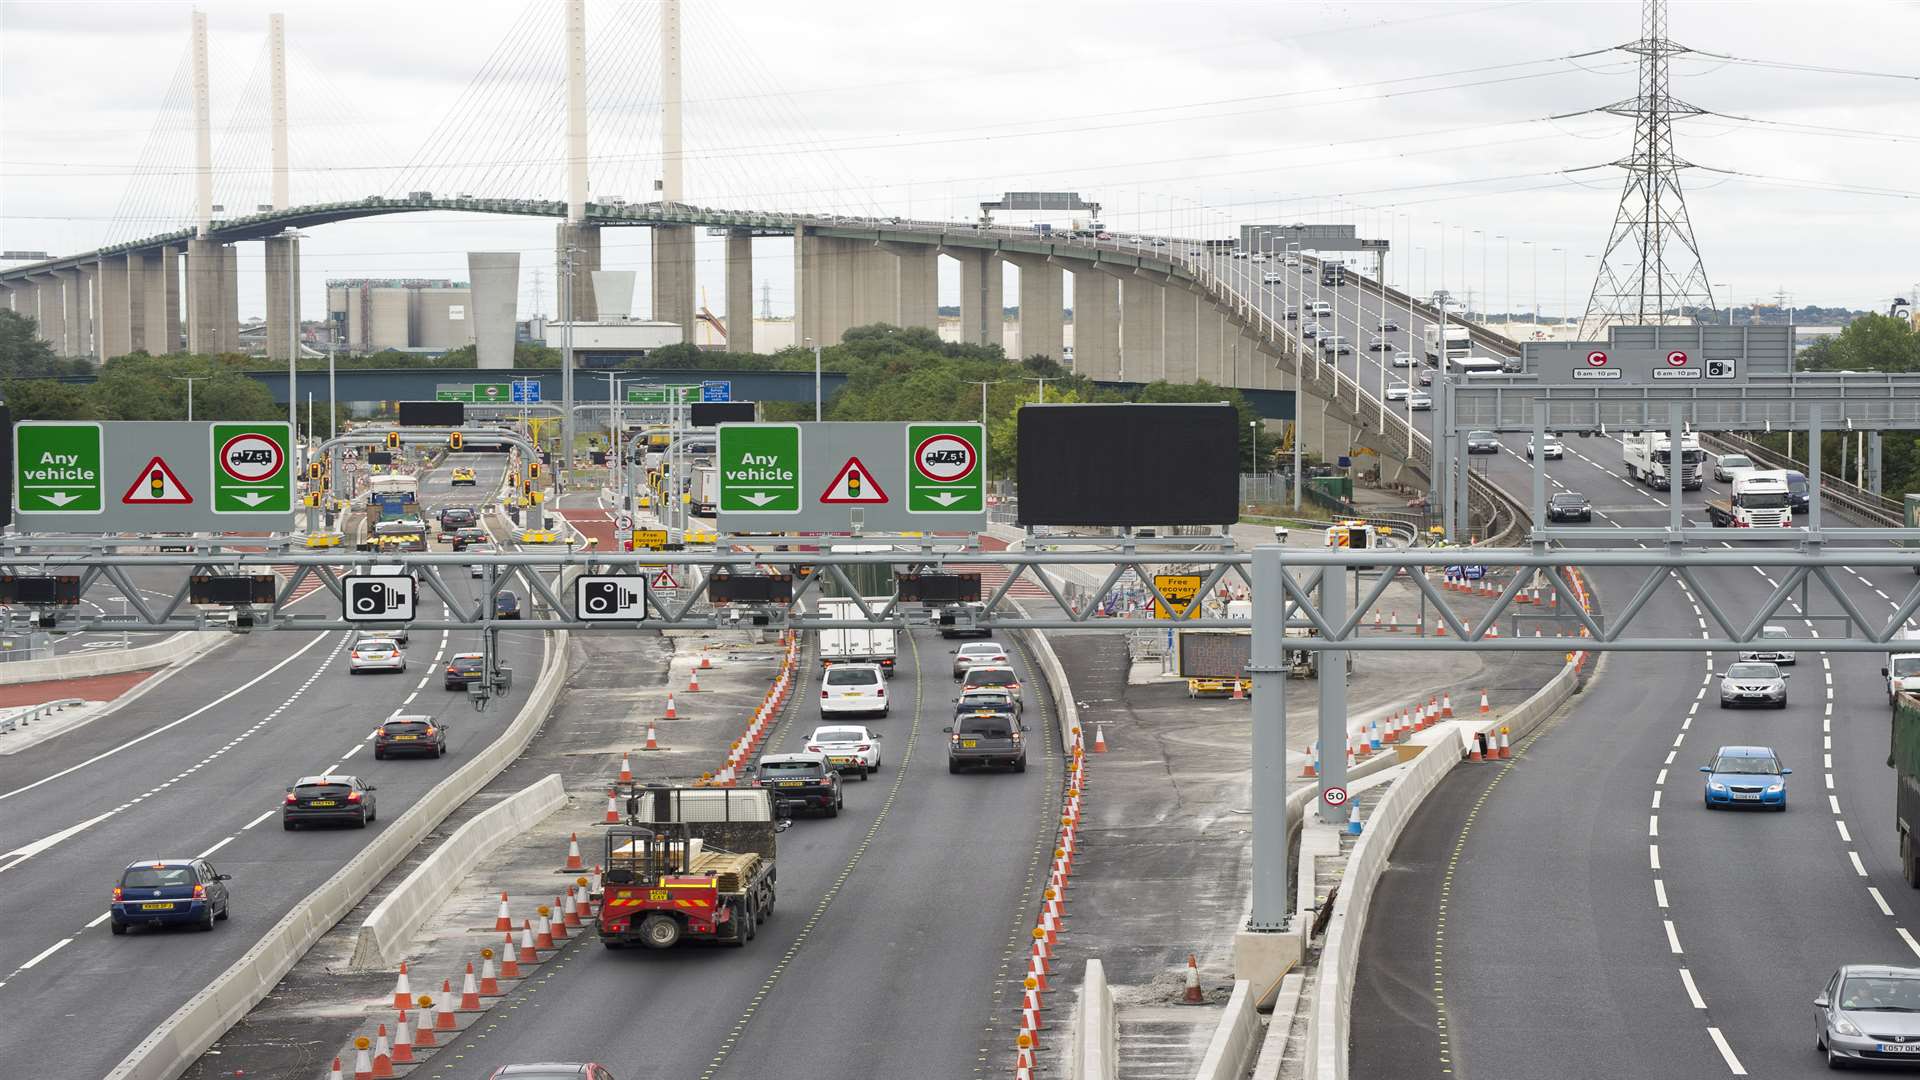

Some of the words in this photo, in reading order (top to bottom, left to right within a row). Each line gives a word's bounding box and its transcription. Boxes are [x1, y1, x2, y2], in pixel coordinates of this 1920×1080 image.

[40, 452, 78, 468] Any
[741, 452, 778, 469] Any
[24, 467, 95, 481] vehicle
[726, 468, 793, 481] vehicle
[1328, 792, 1344, 800] 50
